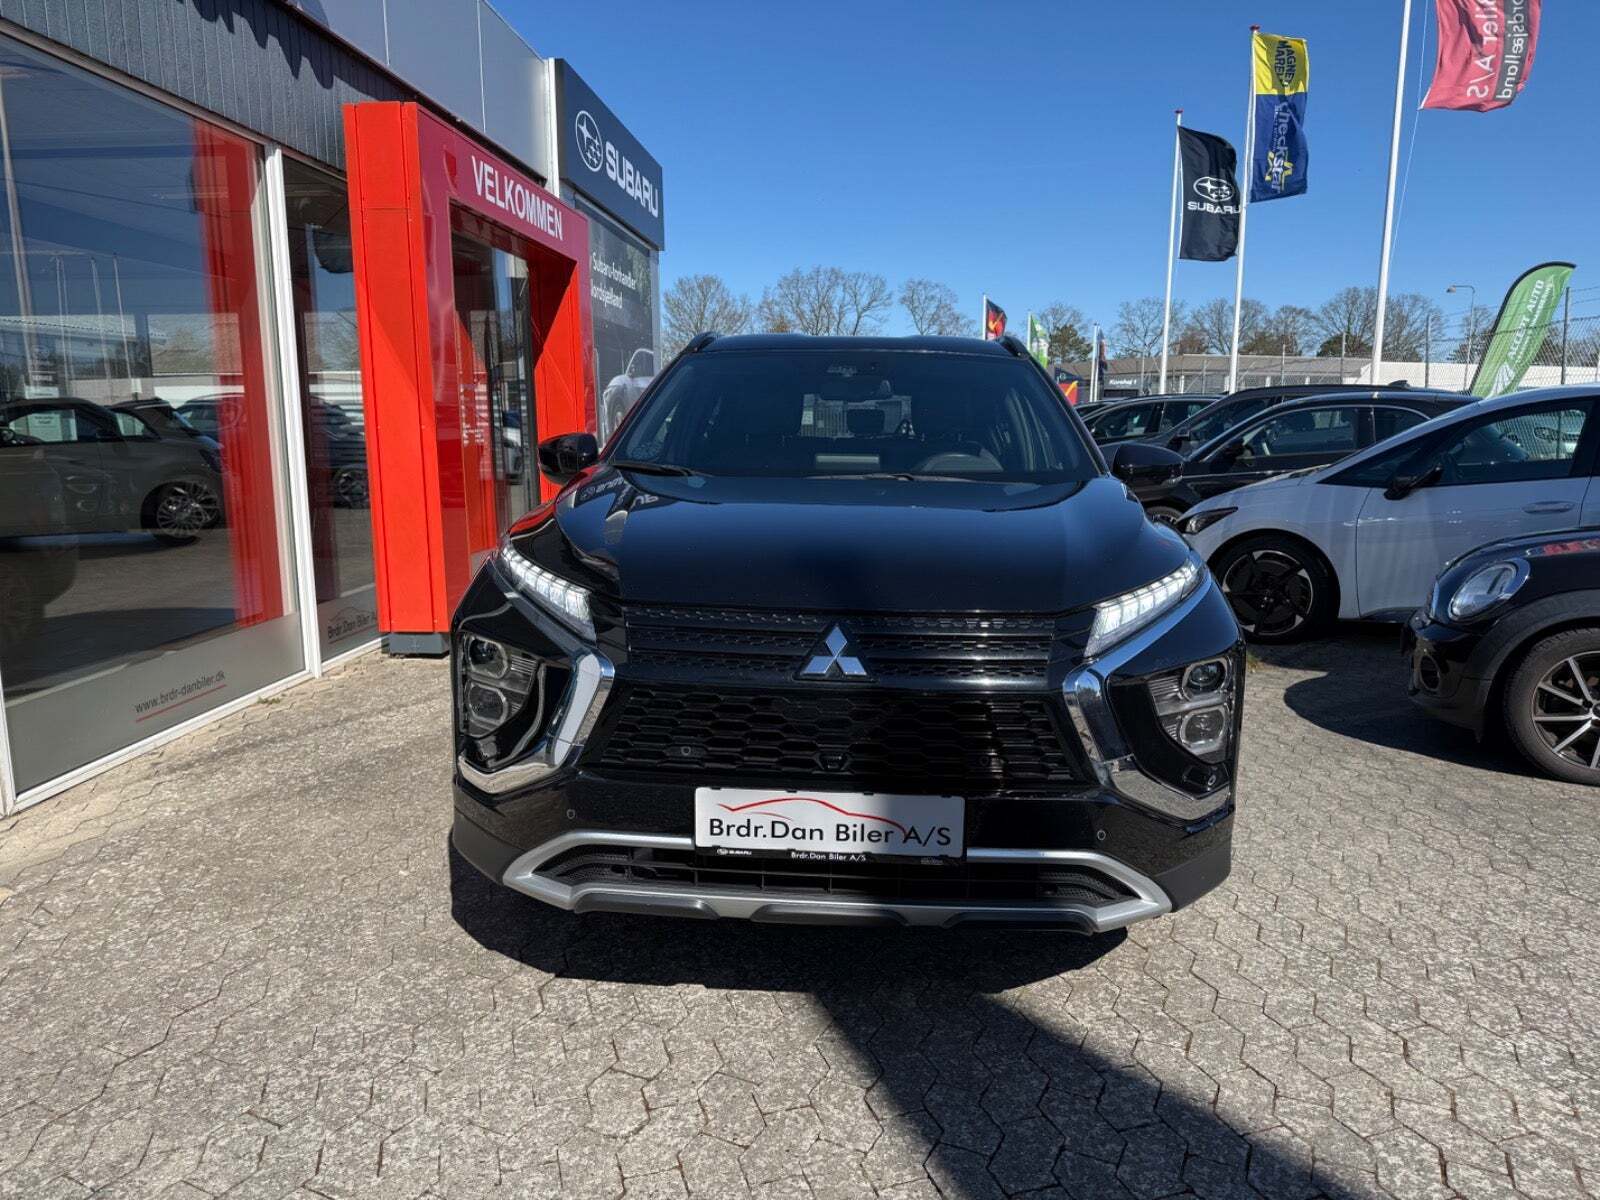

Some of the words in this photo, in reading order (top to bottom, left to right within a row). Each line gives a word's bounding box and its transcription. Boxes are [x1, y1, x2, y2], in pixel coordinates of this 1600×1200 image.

[605, 141, 658, 218] SUBARU
[471, 155, 564, 241] VELKOMMEN
[1187, 201, 1242, 215] SUBARU
[1526, 279, 1545, 313] AUTO
[835, 823, 893, 843] Biler
[902, 826, 951, 847] A/S
